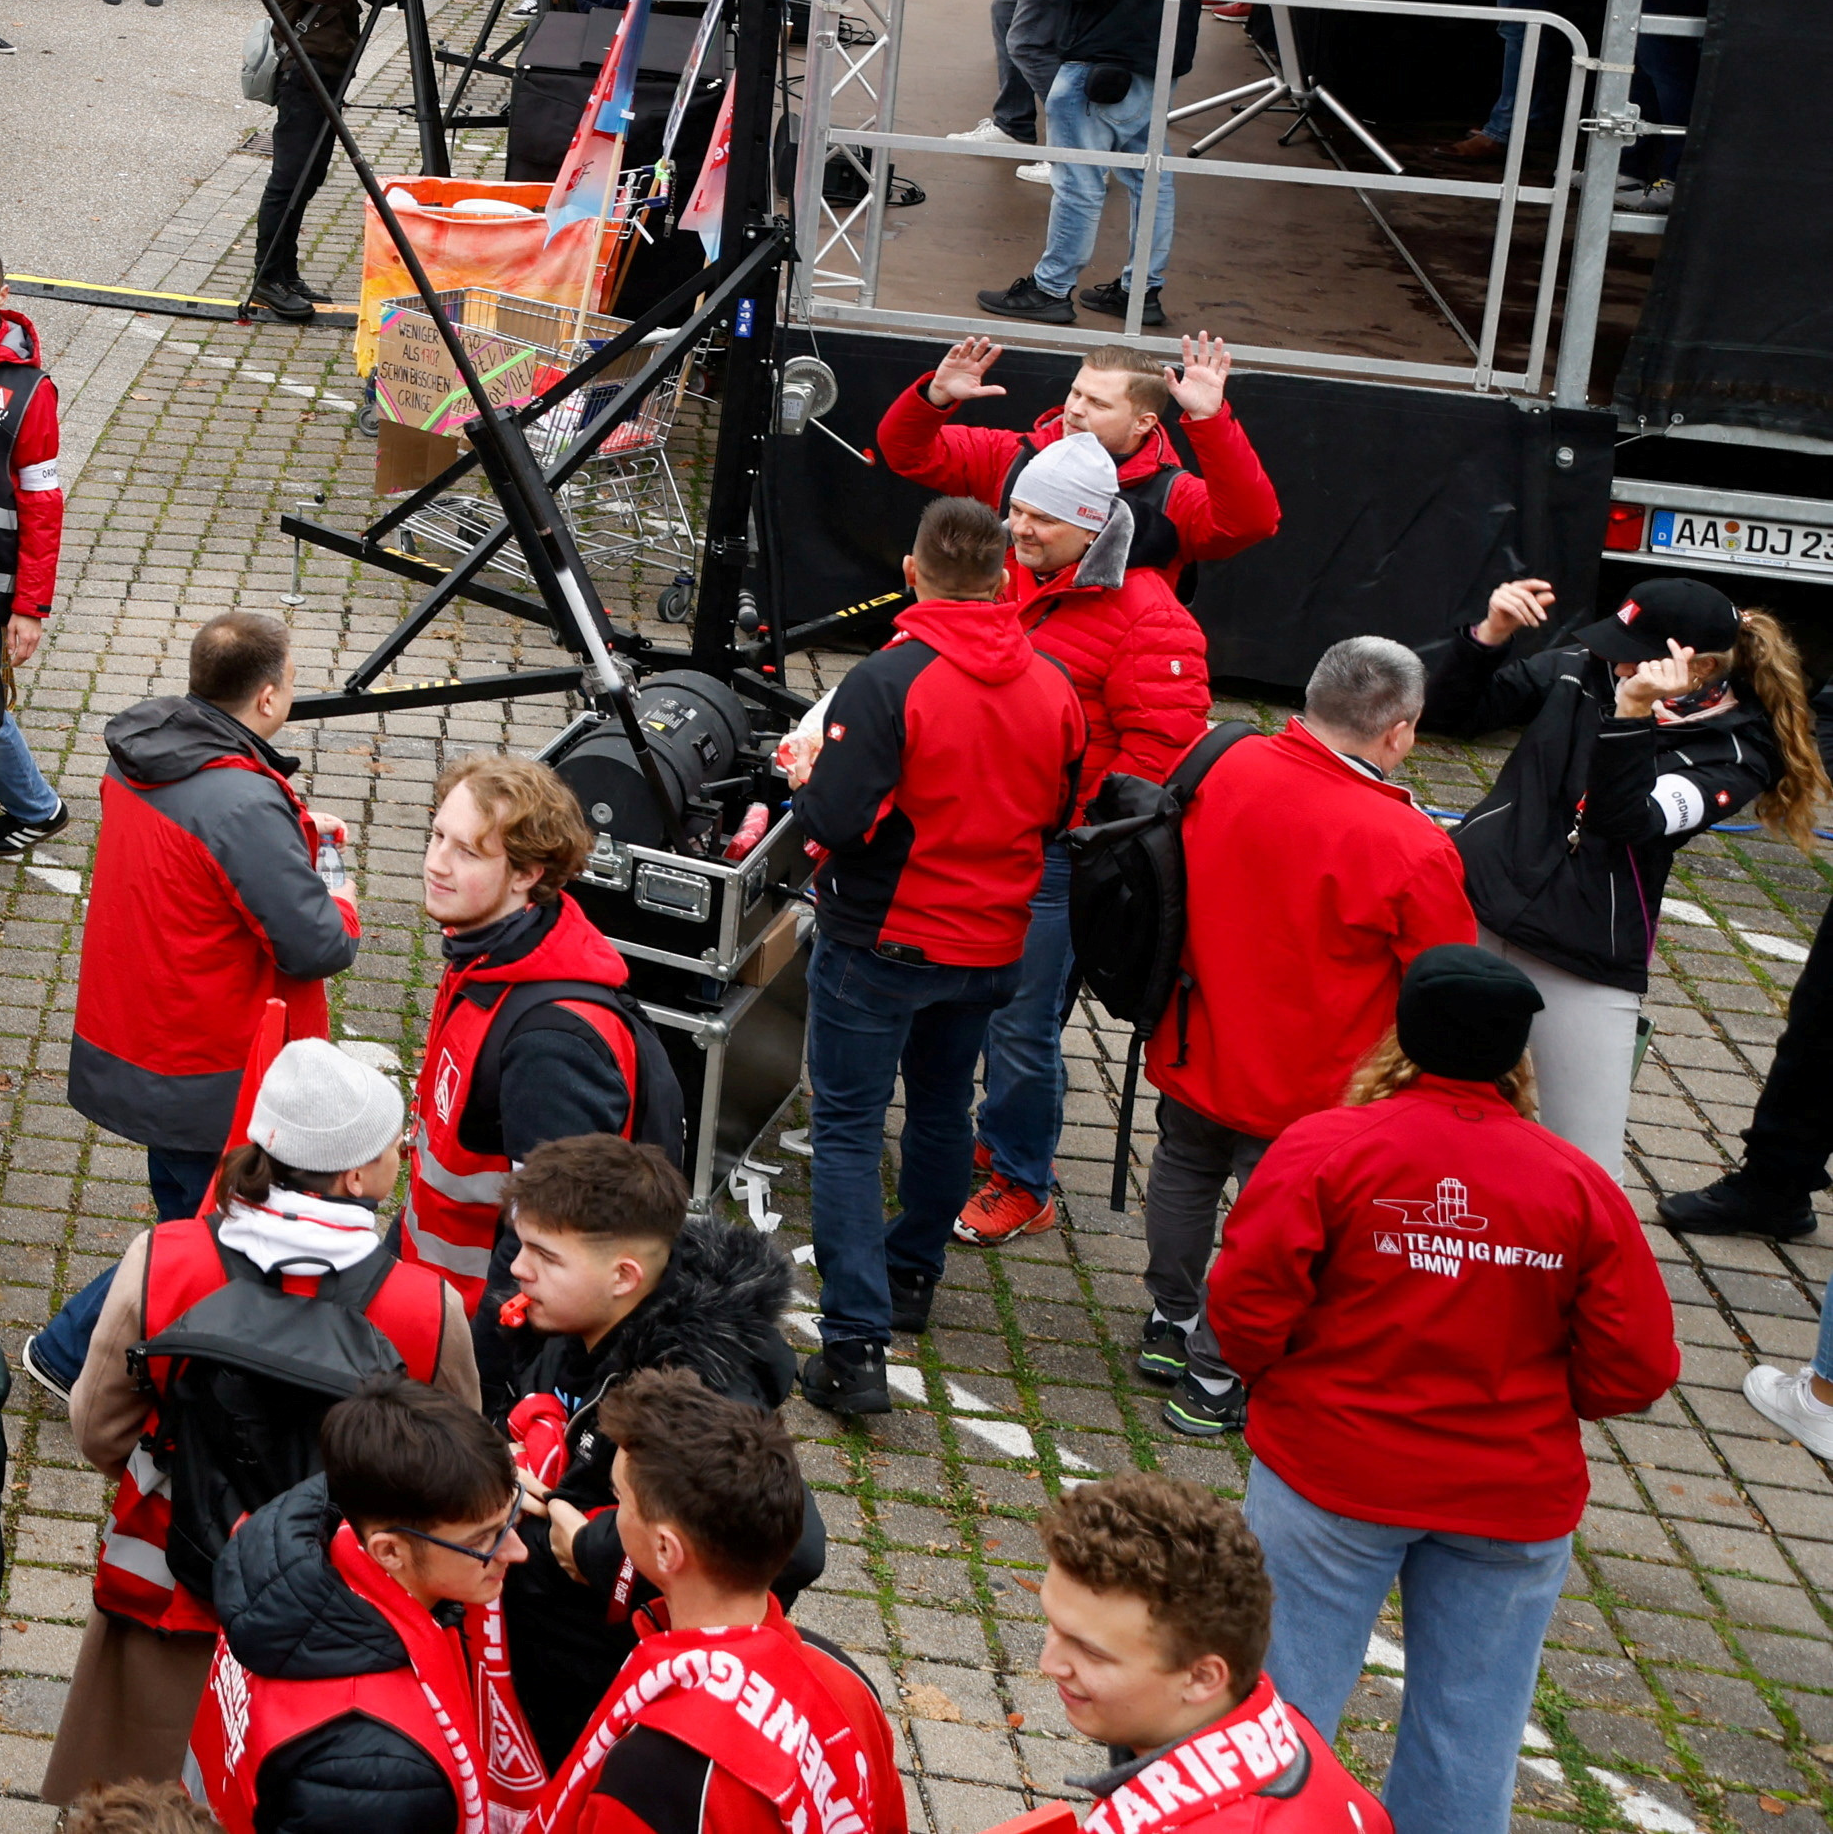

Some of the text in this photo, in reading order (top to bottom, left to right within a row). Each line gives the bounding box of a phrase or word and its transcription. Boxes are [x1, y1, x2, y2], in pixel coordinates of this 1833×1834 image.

[397, 322, 440, 344] WENIGER
[401, 346, 441, 367] ALS 170?
[379, 361, 452, 394] SCHON BISSCHEN
[397, 388, 433, 414] CRINGE
[42, 468, 57, 479] ORD
[1658, 531, 1667, 541] D
[1675, 518, 1720, 550] AA
[1744, 524, 1792, 556] DJ
[1403, 1232, 1564, 1270] TEAM IG METALL
[1408, 1253, 1461, 1279] BMW
